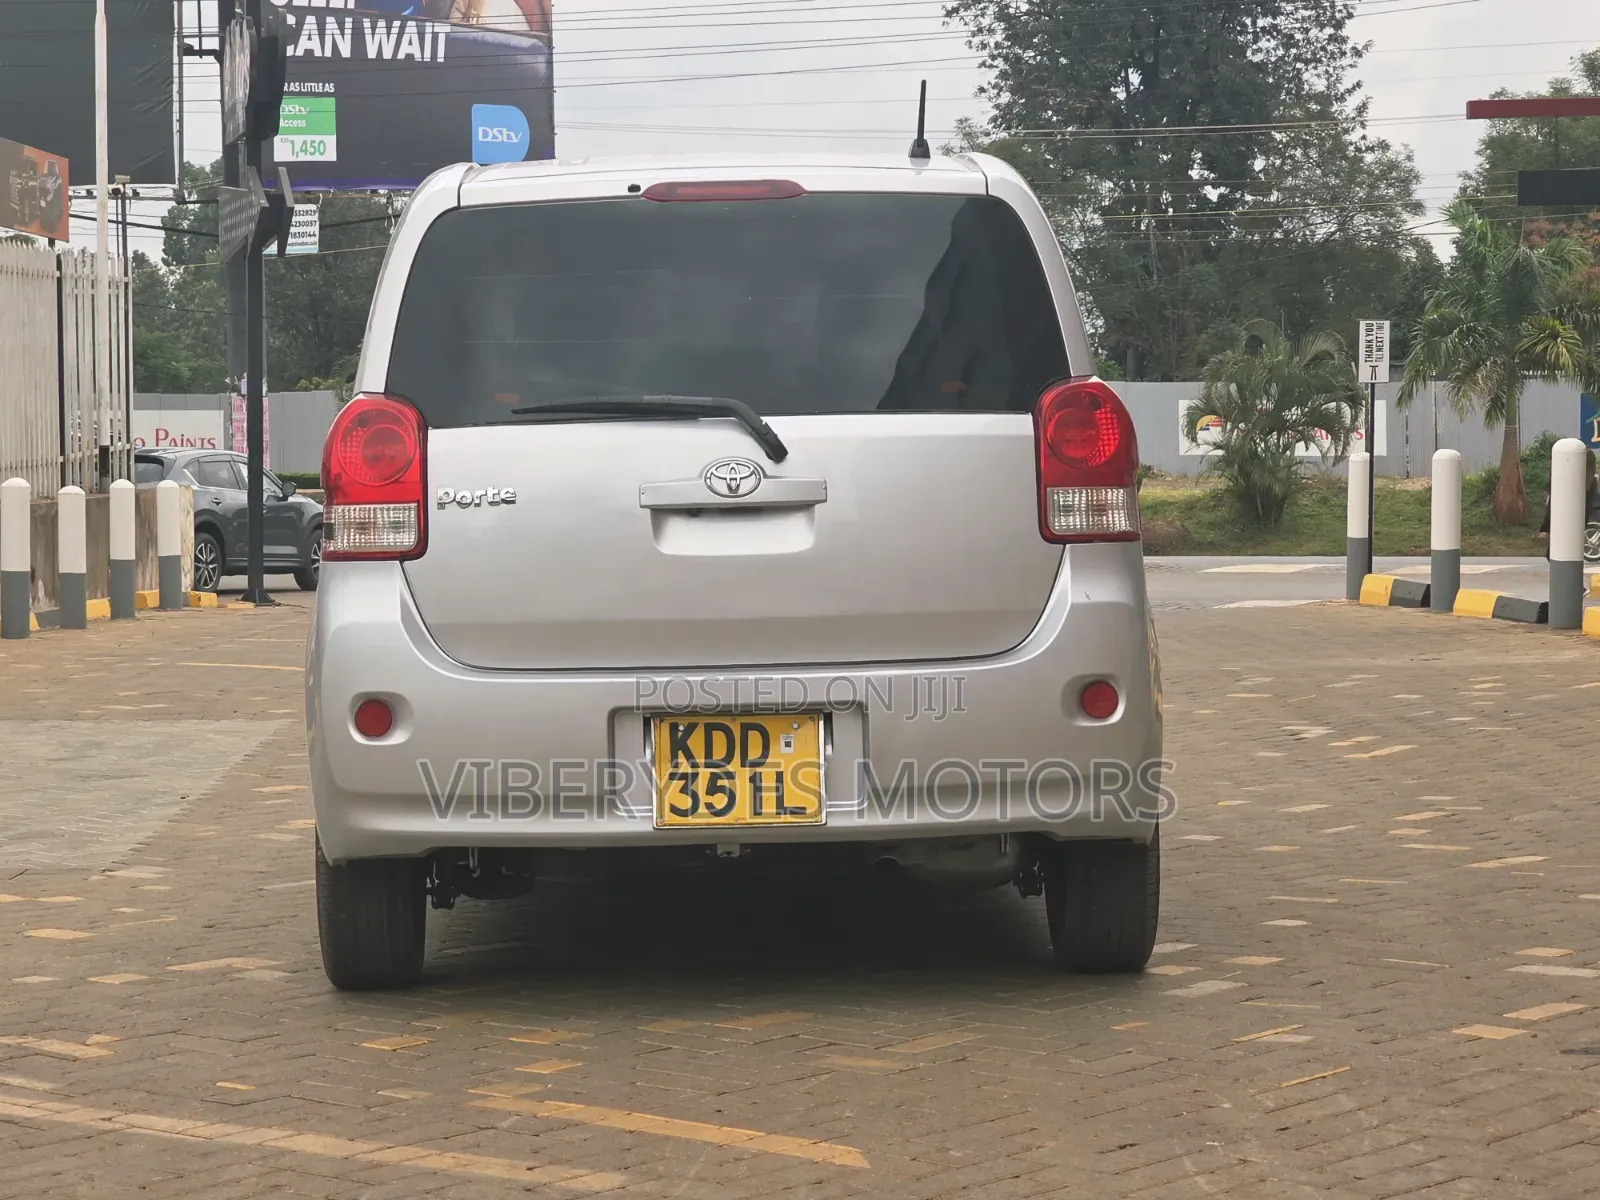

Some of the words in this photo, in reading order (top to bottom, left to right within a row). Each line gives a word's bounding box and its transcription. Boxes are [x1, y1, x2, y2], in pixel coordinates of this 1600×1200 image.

[363, 18, 450, 62] WAIT
[289, 82, 300, 92] AS
[301, 82, 323, 93] LITTLE
[324, 83, 335, 93] AS
[280, 119, 306, 127] Access
[478, 126, 523, 143] DStv
[290, 140, 326, 158] 1,450
[1364, 322, 1375, 337] YOU
[1375, 322, 1385, 335] TIME
[1364, 339, 1375, 363] THANK
[1375, 335, 1384, 353] NEXT
[1375, 353, 1384, 363] TILL
[437, 486, 517, 510] Porte
[669, 722, 770, 769] KDD
[669, 770, 807, 818] 351L
